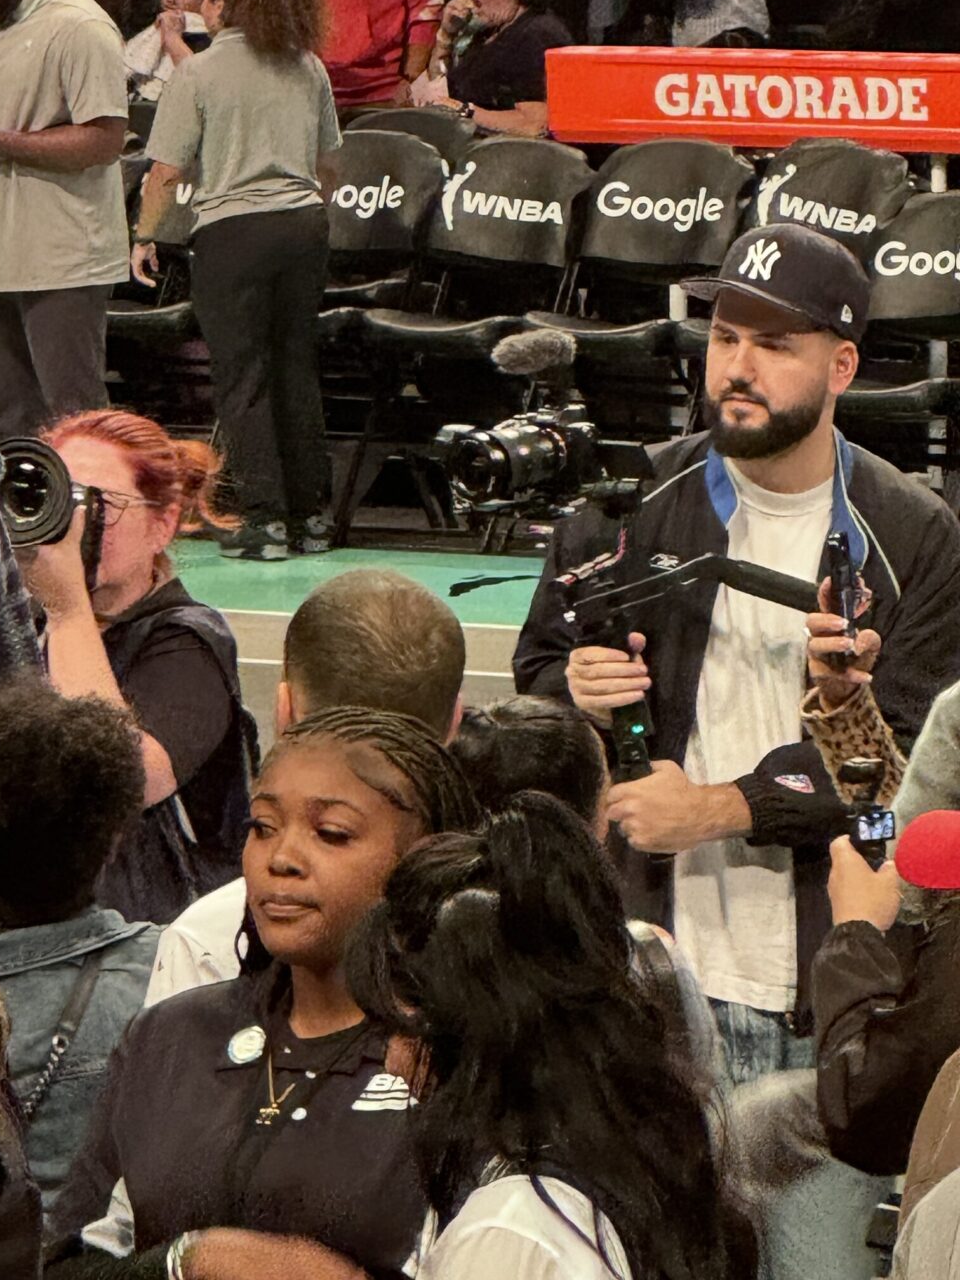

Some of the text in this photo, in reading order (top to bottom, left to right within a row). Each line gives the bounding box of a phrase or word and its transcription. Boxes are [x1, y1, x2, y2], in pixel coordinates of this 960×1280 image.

[654, 73, 929, 121] GATORADE
[331, 175, 405, 219] ogle
[462, 190, 563, 225] WNBA
[596, 181, 724, 232] Google
[778, 192, 877, 235] WNBA
[738, 238, 782, 281] NY
[874, 241, 960, 282] Goo
